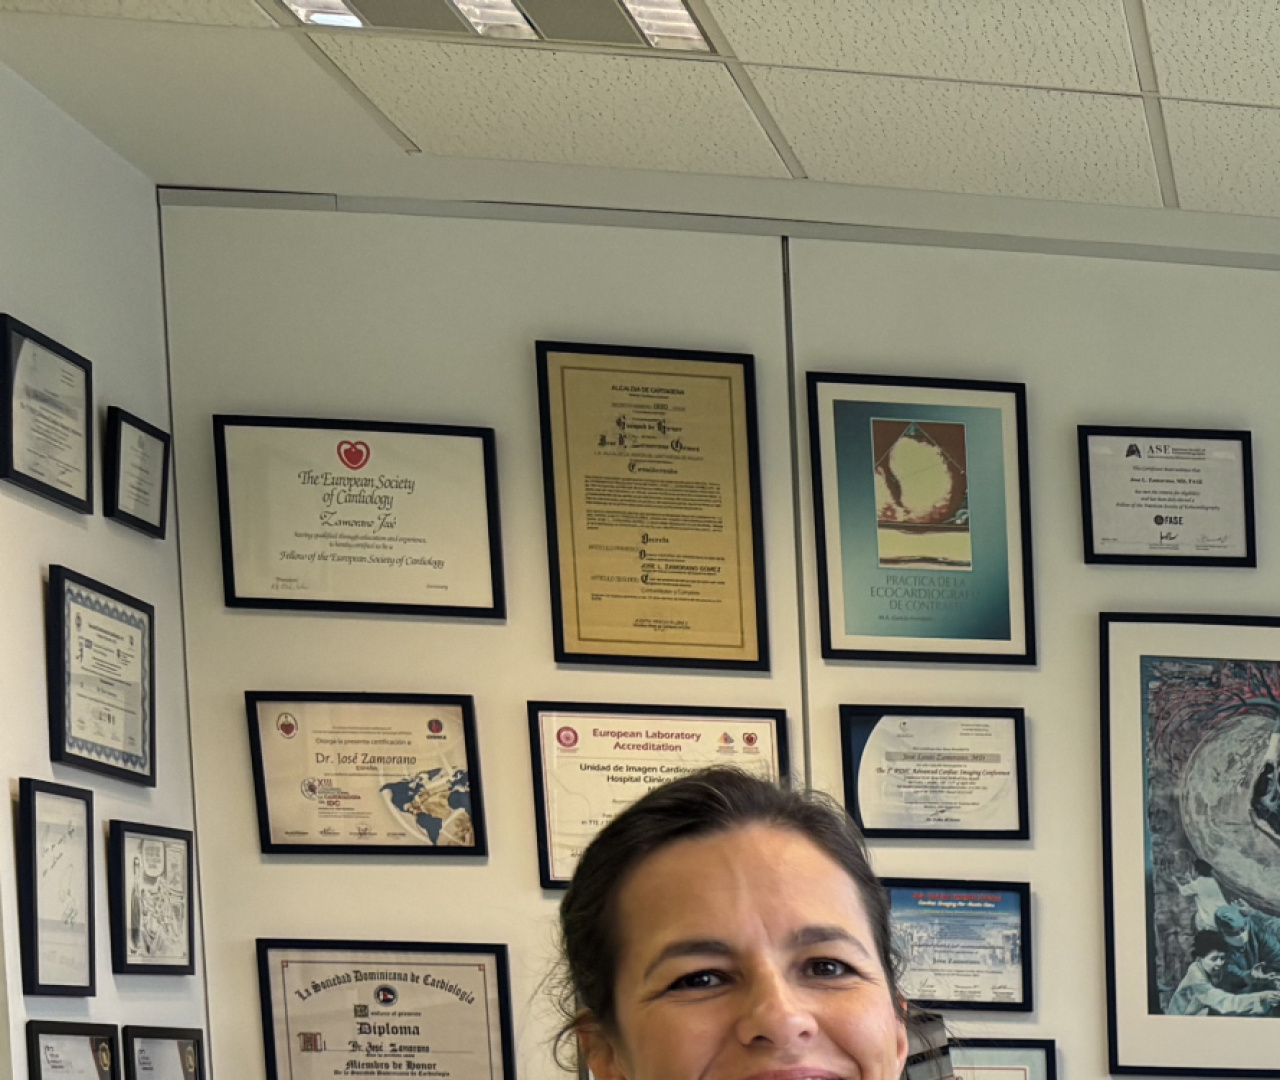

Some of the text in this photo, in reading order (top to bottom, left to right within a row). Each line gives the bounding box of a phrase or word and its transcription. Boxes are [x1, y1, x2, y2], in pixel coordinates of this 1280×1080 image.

[1147, 445, 1171, 454] ASE
[298, 470, 415, 495] The European Society
[322, 488, 393, 510] of Cardiology
[1164, 516, 1183, 525] FASE
[592, 728, 702, 742] European Laboratory
[613, 741, 682, 752] Accreditation
[315, 753, 417, 765] Dr. José Zamorano
[579, 763, 658, 775] Unidad de Imagen
[311, 973, 352, 993] Sociedad
[352, 969, 408, 983] Dominicana
[410, 971, 420, 983] de
[422, 974, 475, 1005] Cardiología
[356, 1022, 420, 1036] Diploma
[345, 1060, 437, 1071] Miembro de Honor
